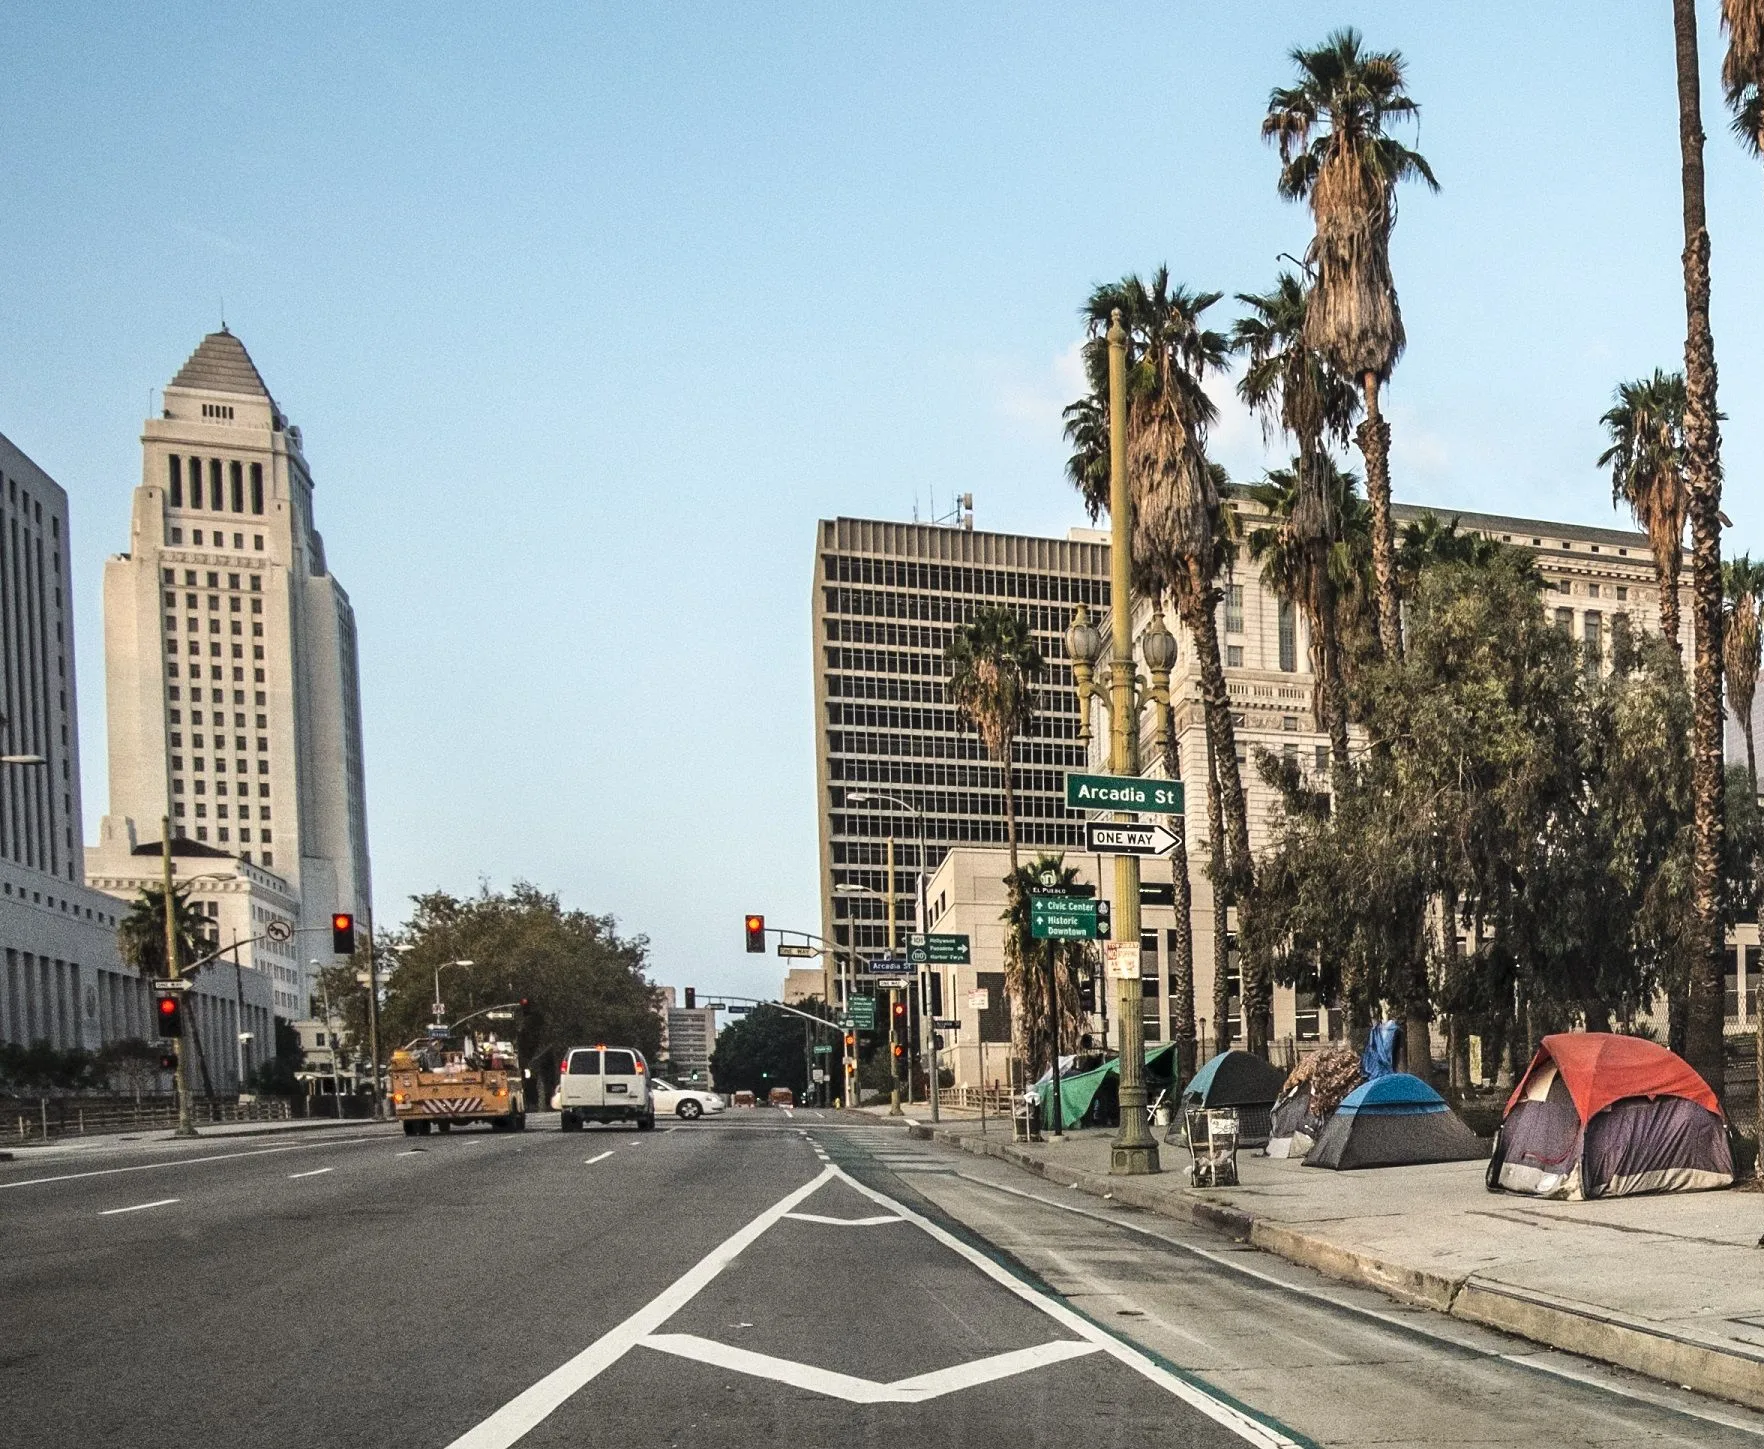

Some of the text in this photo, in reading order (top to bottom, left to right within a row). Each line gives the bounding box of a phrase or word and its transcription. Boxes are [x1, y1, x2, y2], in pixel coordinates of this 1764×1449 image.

[1078, 784, 1174, 804] Arcadia St
[1097, 832, 1153, 845] ONE WAY
[1047, 901, 1094, 911] Civic Center
[1047, 916, 1078, 925] Historic
[1048, 927, 1087, 936] Downtown
[872, 962, 901, 970] Arcadia
